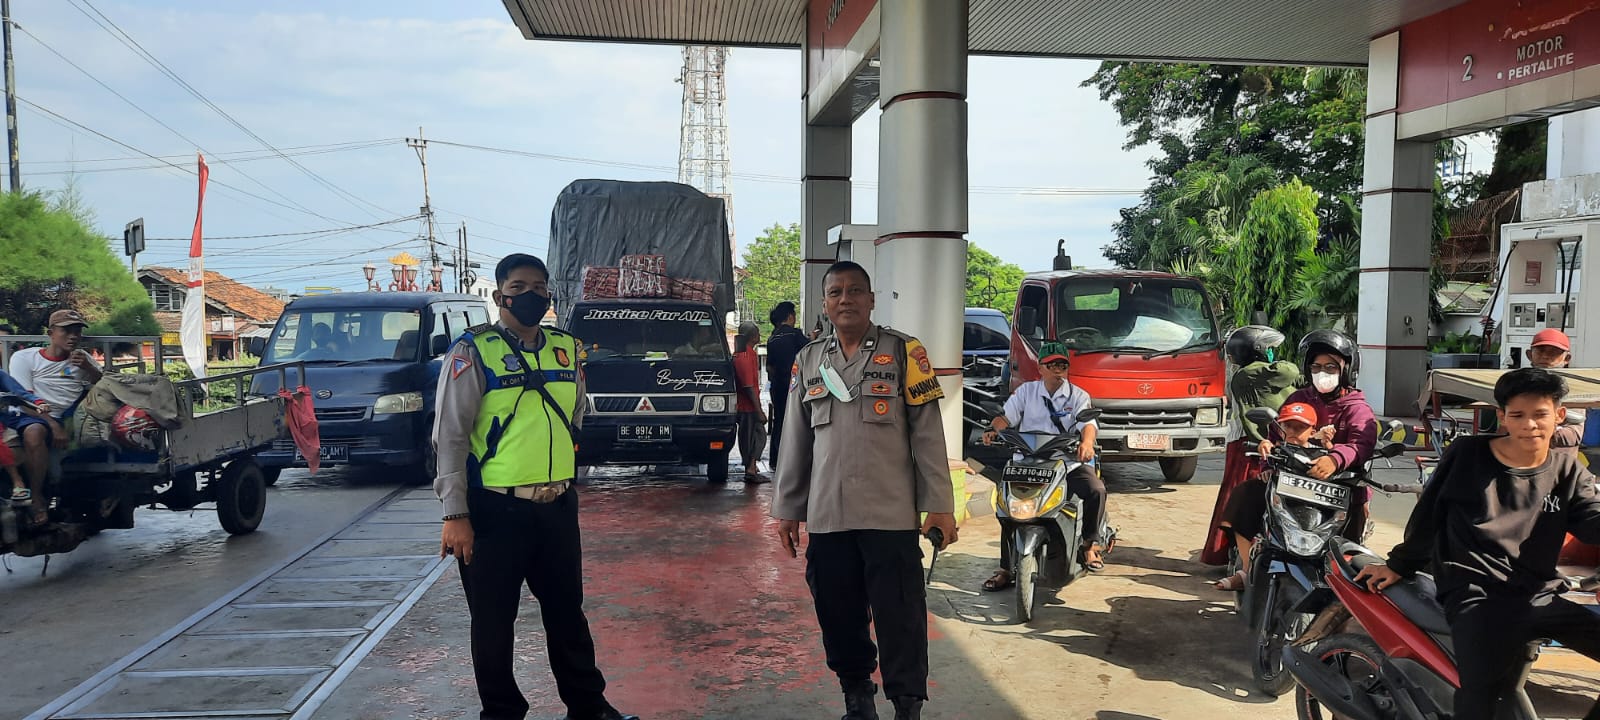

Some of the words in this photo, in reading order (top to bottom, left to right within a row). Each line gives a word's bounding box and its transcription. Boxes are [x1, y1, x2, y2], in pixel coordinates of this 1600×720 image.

[1516, 36, 1563, 61] MOTOR
[1462, 54, 1474, 82] 2
[1508, 52, 1575, 81] PERTALITE
[584, 309, 649, 320] Justice
[648, 309, 681, 321] For
[863, 371, 896, 381] POLRI
[1187, 382, 1212, 396] 07
[620, 425, 631, 436] BE
[635, 425, 653, 436] 8914
[1281, 475, 1297, 488] BE
[1297, 479, 1323, 493] 2474
[1324, 486, 1347, 499] ACW
[1543, 494, 1561, 513] NY
